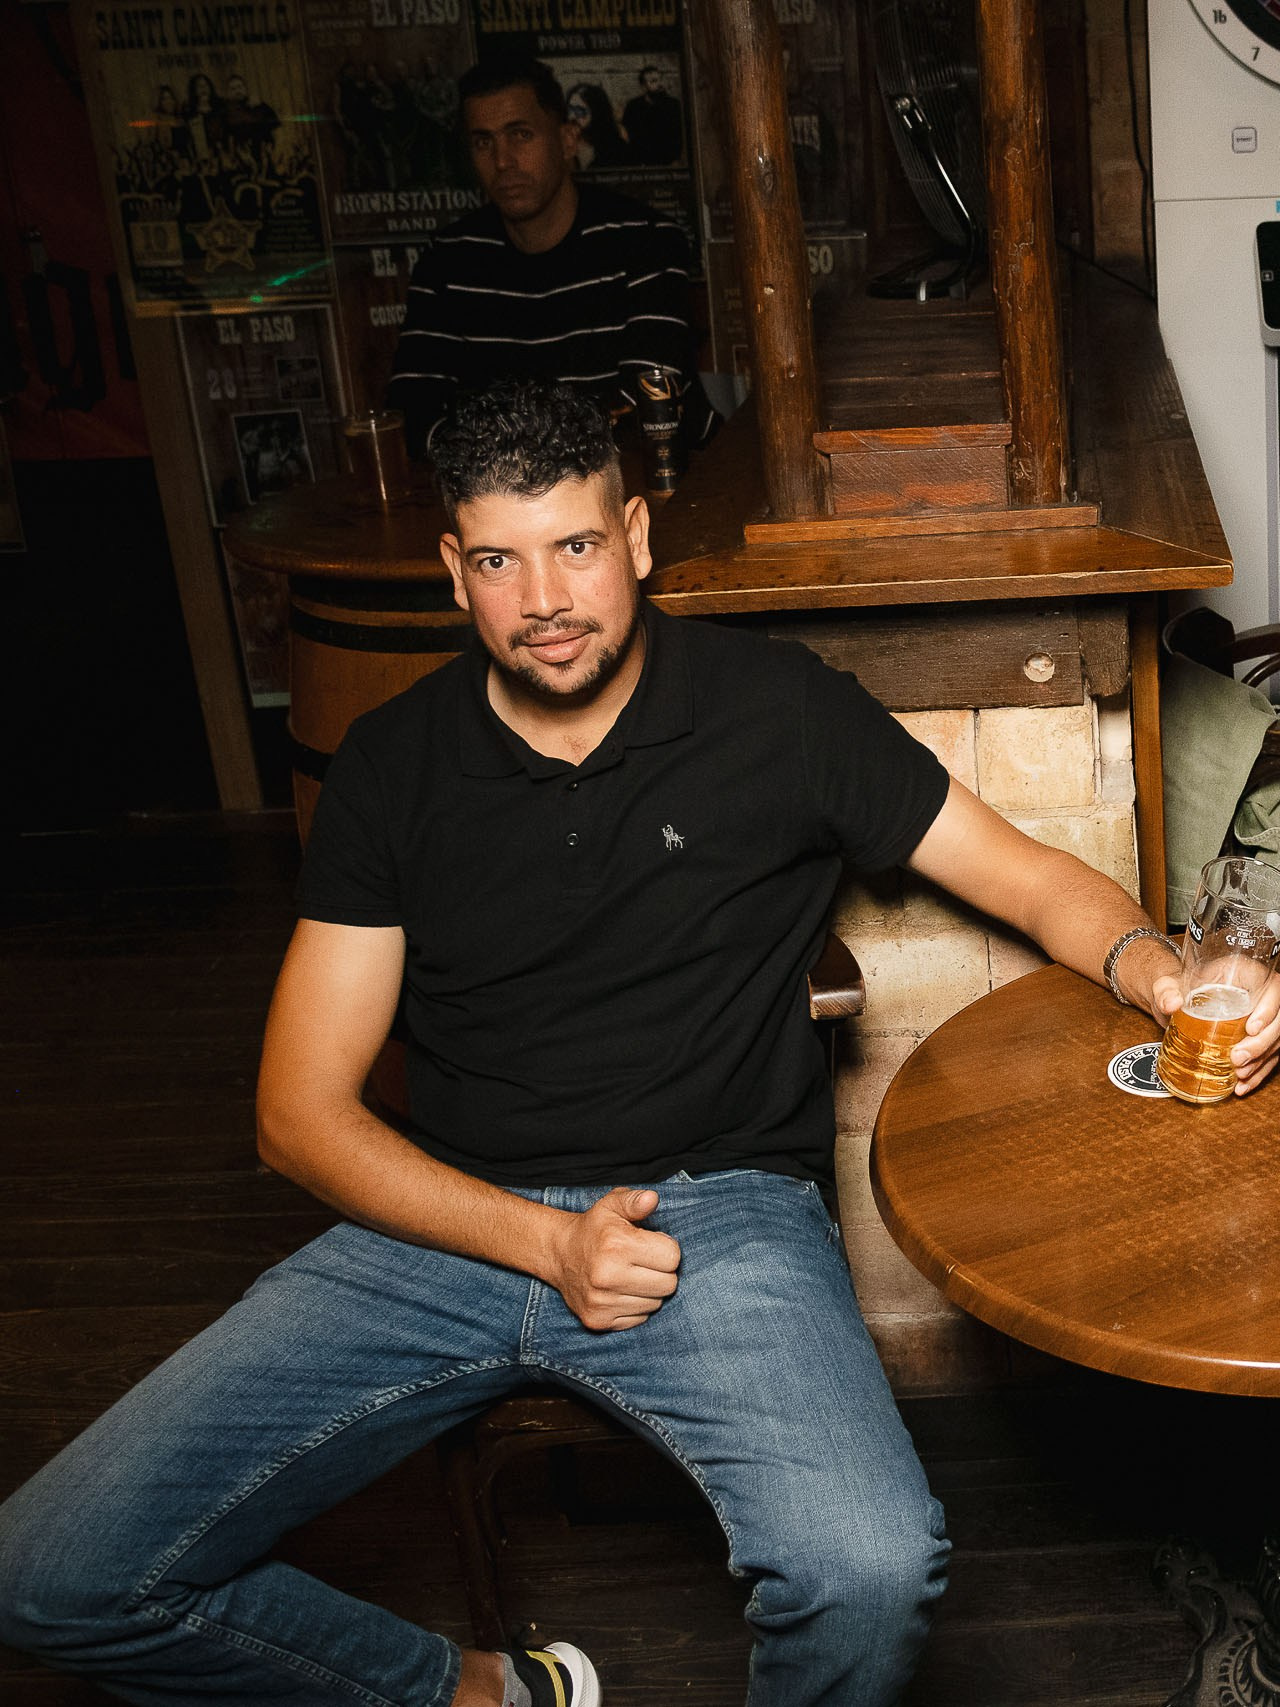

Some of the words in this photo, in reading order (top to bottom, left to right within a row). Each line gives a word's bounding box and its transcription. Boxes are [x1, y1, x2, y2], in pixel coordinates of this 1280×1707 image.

[96, 10, 167, 49] SANTI
[174, 4, 291, 46] CAMPILLO
[370, 0, 398, 27] EL
[400, 0, 461, 26] PASO
[479, 0, 552, 32] SANTI
[1212, 9, 1227, 24] 16
[1251, 47, 1261, 62] 7
[398, 187, 483, 213] STATION
[387, 217, 438, 232] BAND
[370, 247, 398, 278] EL
[807, 244, 834, 275] SO
[369, 303, 408, 327] CONC
[216, 318, 242, 345] EL
[249, 315, 296, 343] PASO
